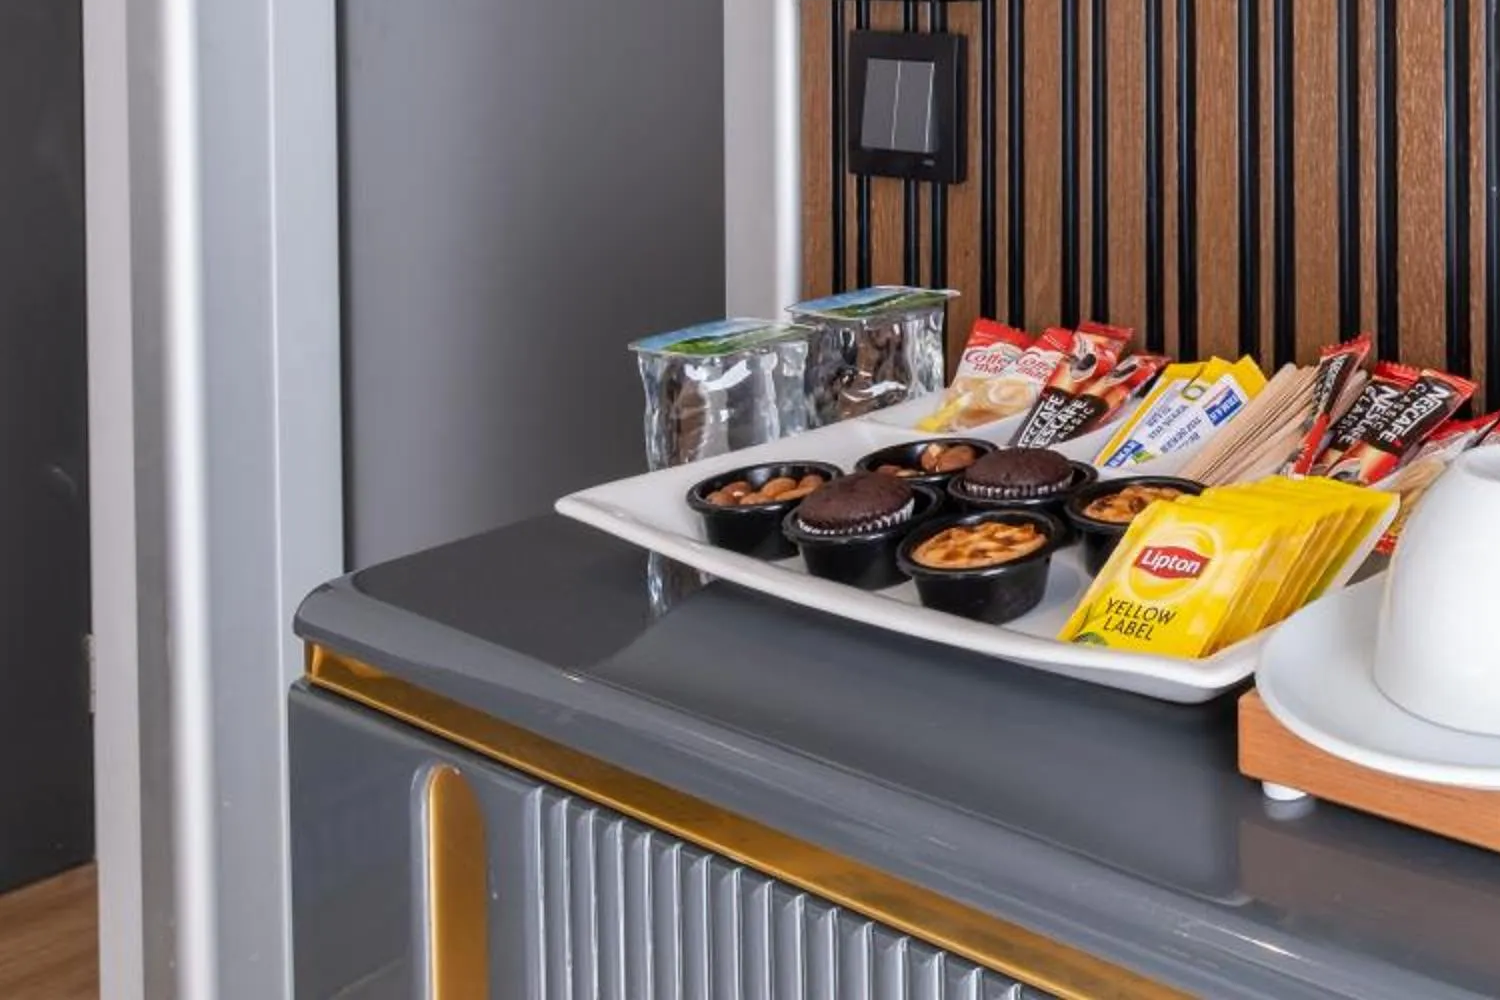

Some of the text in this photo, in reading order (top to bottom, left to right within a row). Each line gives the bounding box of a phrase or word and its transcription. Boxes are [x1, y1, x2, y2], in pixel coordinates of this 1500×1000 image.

[1141, 549, 1201, 573] Lipton
[1105, 598, 1177, 625] YELLOW
[1103, 616, 1154, 641] LABEL
